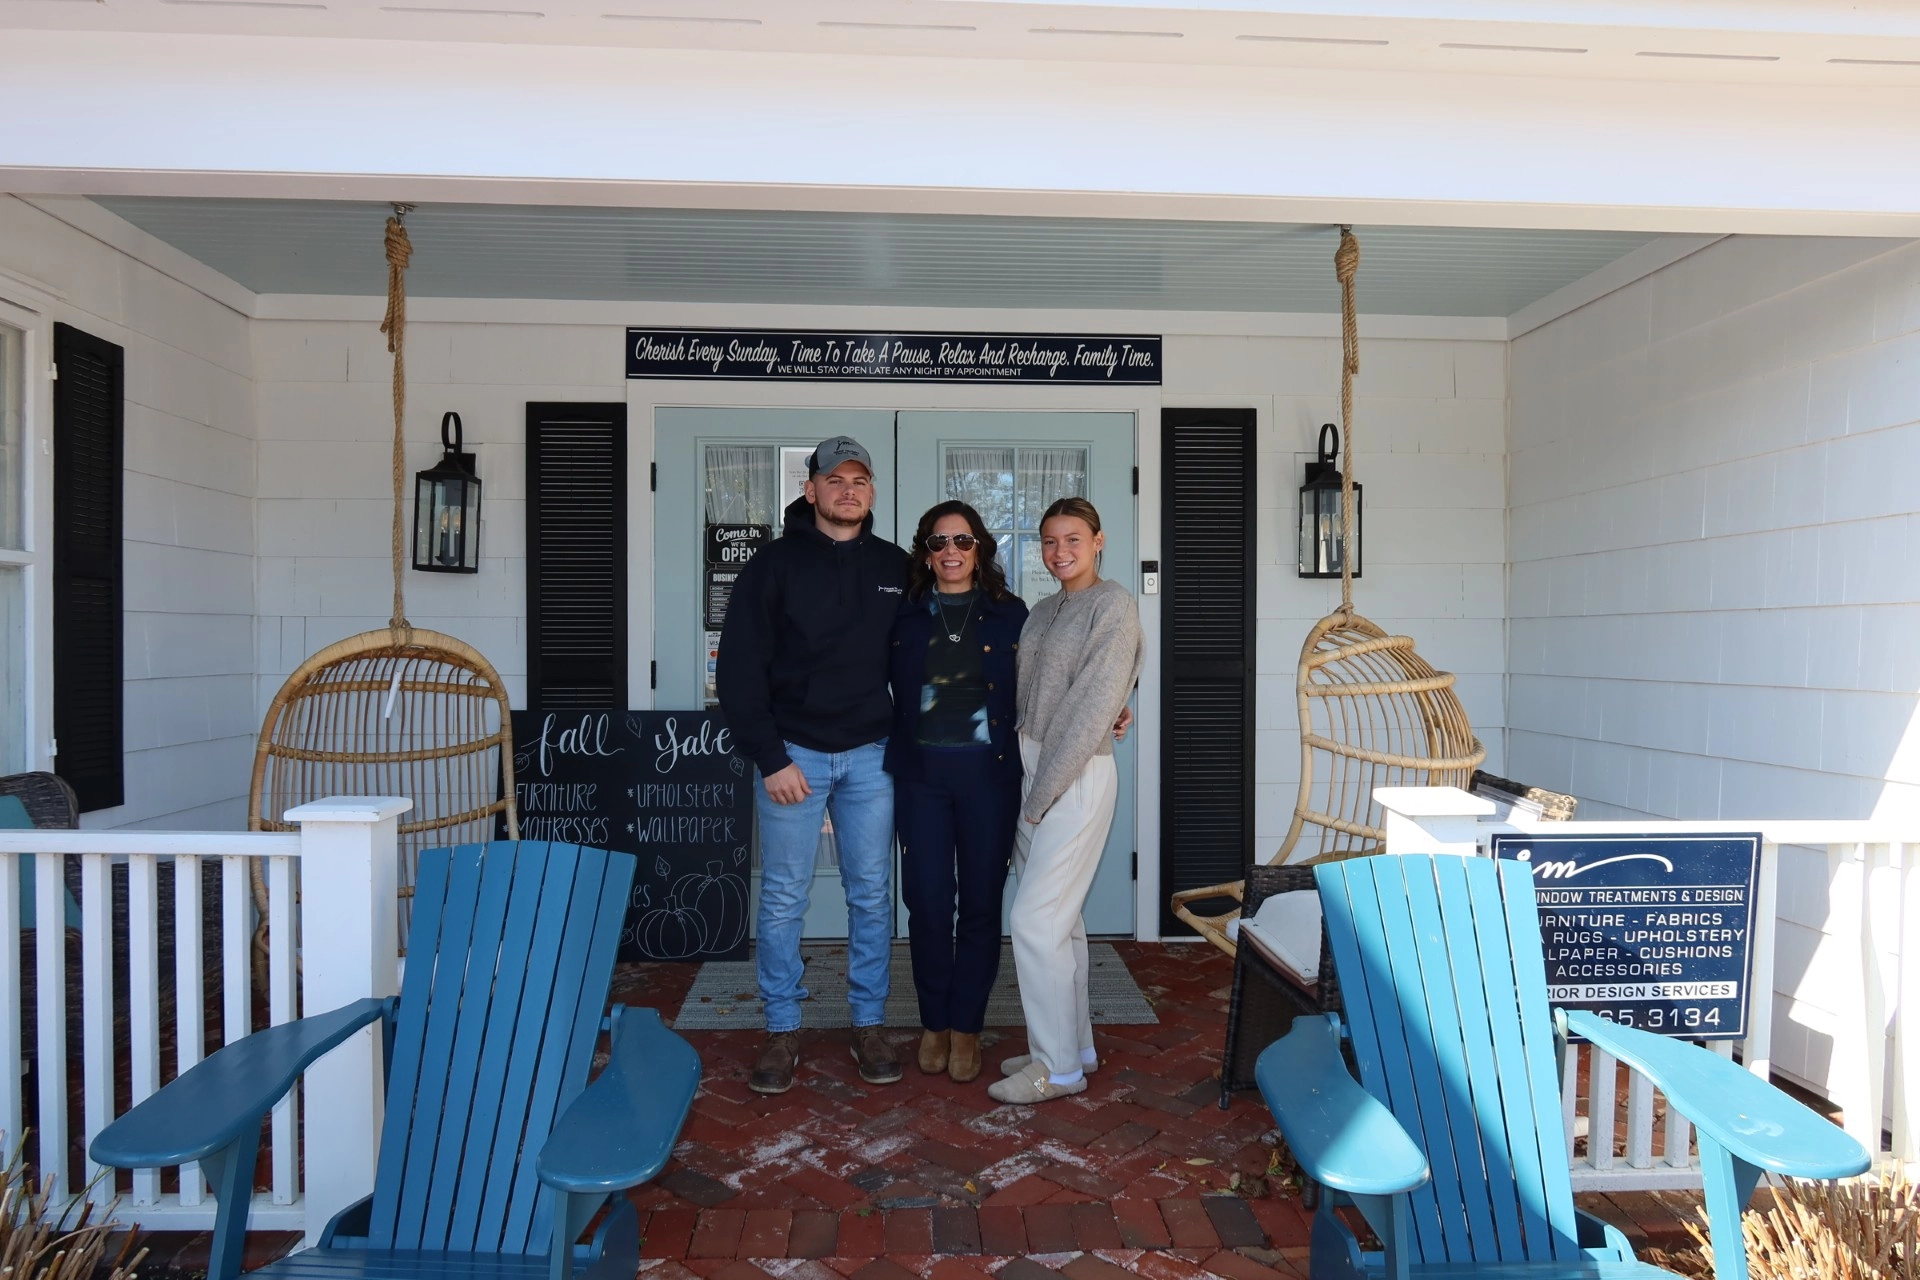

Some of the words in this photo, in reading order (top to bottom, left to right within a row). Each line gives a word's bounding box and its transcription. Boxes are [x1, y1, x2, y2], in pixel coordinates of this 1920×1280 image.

[636, 337, 685, 361] Cherish
[688, 338, 724, 373] Every
[726, 339, 780, 373] Sunday.
[790, 340, 821, 362] Time
[825, 340, 840, 362] To
[845, 339, 875, 363] Take
[878, 341, 889, 363] A
[891, 341, 933, 366] Pause,
[938, 341, 976, 365] Relax
[978, 342, 1005, 365] And
[1008, 342, 1070, 377] Recharge.
[1074, 343, 1118, 378] Family
[1121, 344, 1154, 367] Time.
[777, 365, 793, 374] WE
[794, 365, 815, 374] WILL
[817, 365, 840, 374] STAY
[841, 366, 867, 374] OPEN
[869, 366, 891, 375] LATE
[892, 366, 912, 375] ANY
[914, 367, 942, 375] NIGHT
[944, 367, 956, 376] BY
[956, 367, 1022, 376] APPOINTMENT
[716, 528, 748, 542] Come
[749, 526, 761, 538] in
[1537, 891, 1583, 903] INDOW
[1589, 890, 1677, 903] TREATMENTS
[1681, 890, 1690, 902] &
[1695, 889, 1743, 902] DESIGN
[1646, 913, 1723, 927] FABRICS
[1553, 931, 1603, 944] RUGS
[1624, 929, 1745, 943] UPHOLSTERY
[1639, 946, 1733, 959] CUSHIONS
[1556, 963, 1683, 977] ACCESSORIES
[1585, 985, 1646, 998] DESIGN
[1651, 984, 1730, 998] SERVICES
